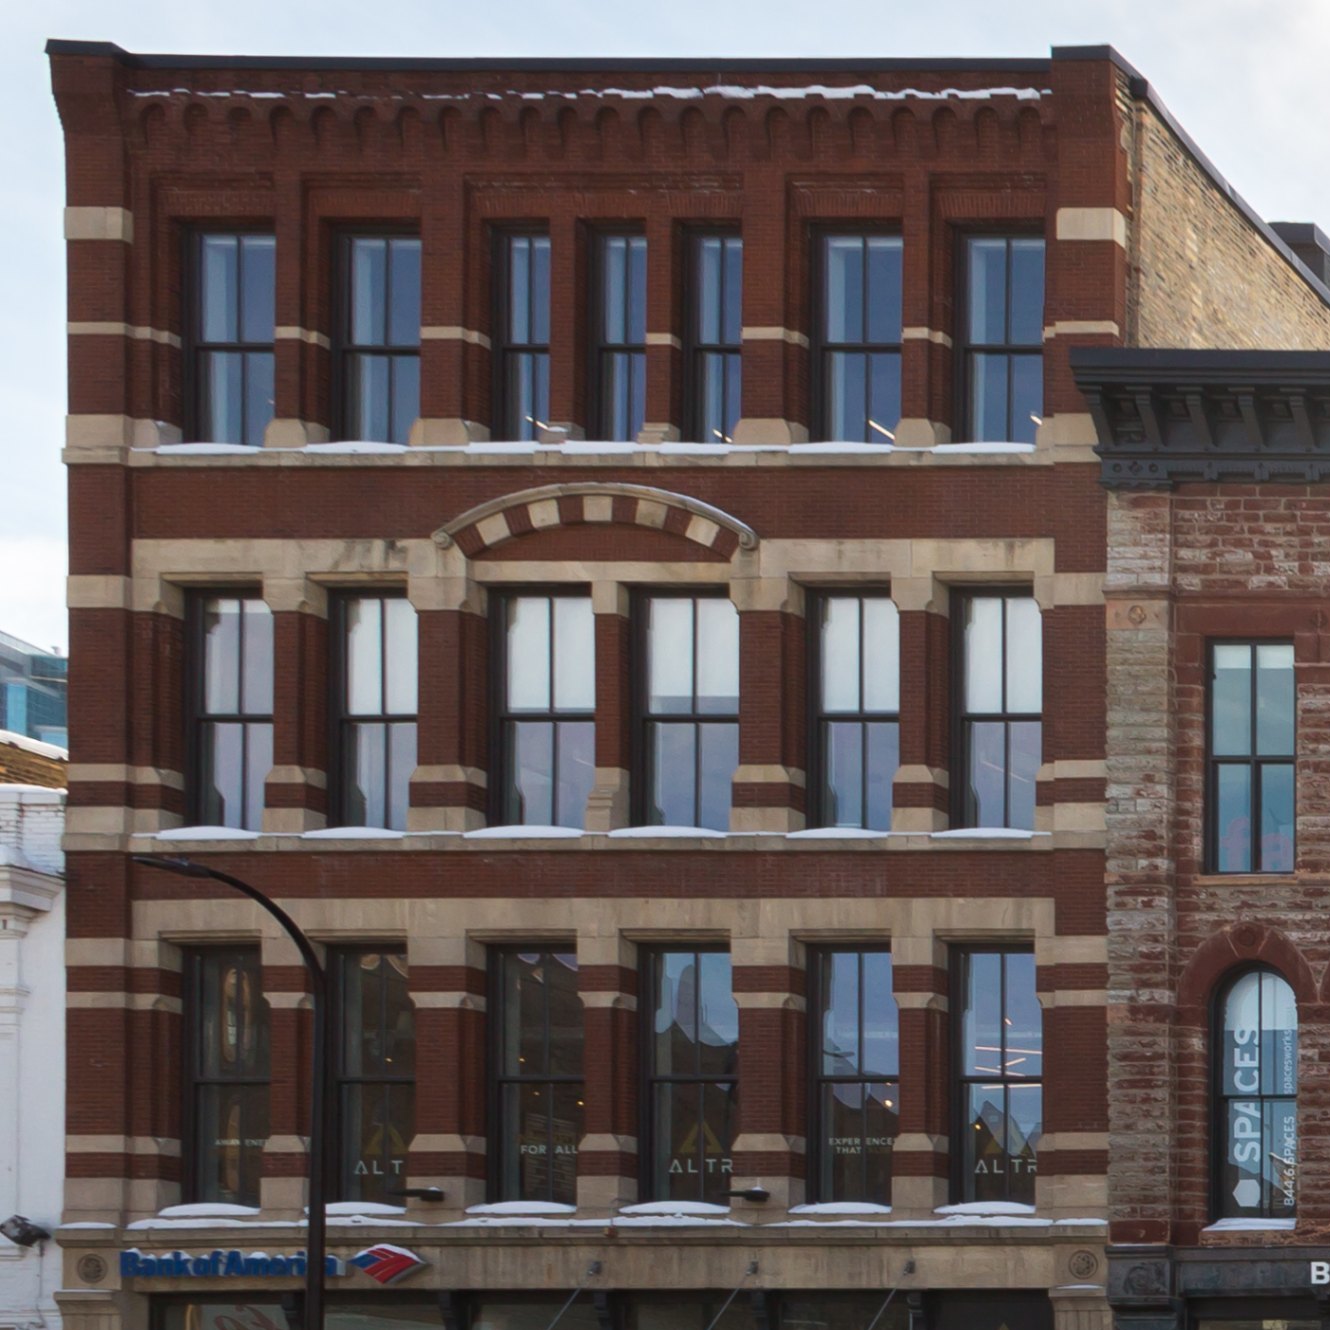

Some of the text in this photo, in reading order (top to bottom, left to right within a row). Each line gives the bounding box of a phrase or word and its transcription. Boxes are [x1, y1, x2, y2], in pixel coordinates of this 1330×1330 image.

[520, 1144, 579, 1155] FOR ALL
[828, 1137, 893, 1147] EXPERENCE
[836, 1146, 862, 1155] THAT
[353, 1160, 404, 1175] ALT
[668, 1158, 734, 1174] ALTR
[974, 1159, 1038, 1175] ALTR
[120, 1249, 338, 1277] Bank of Ameria
